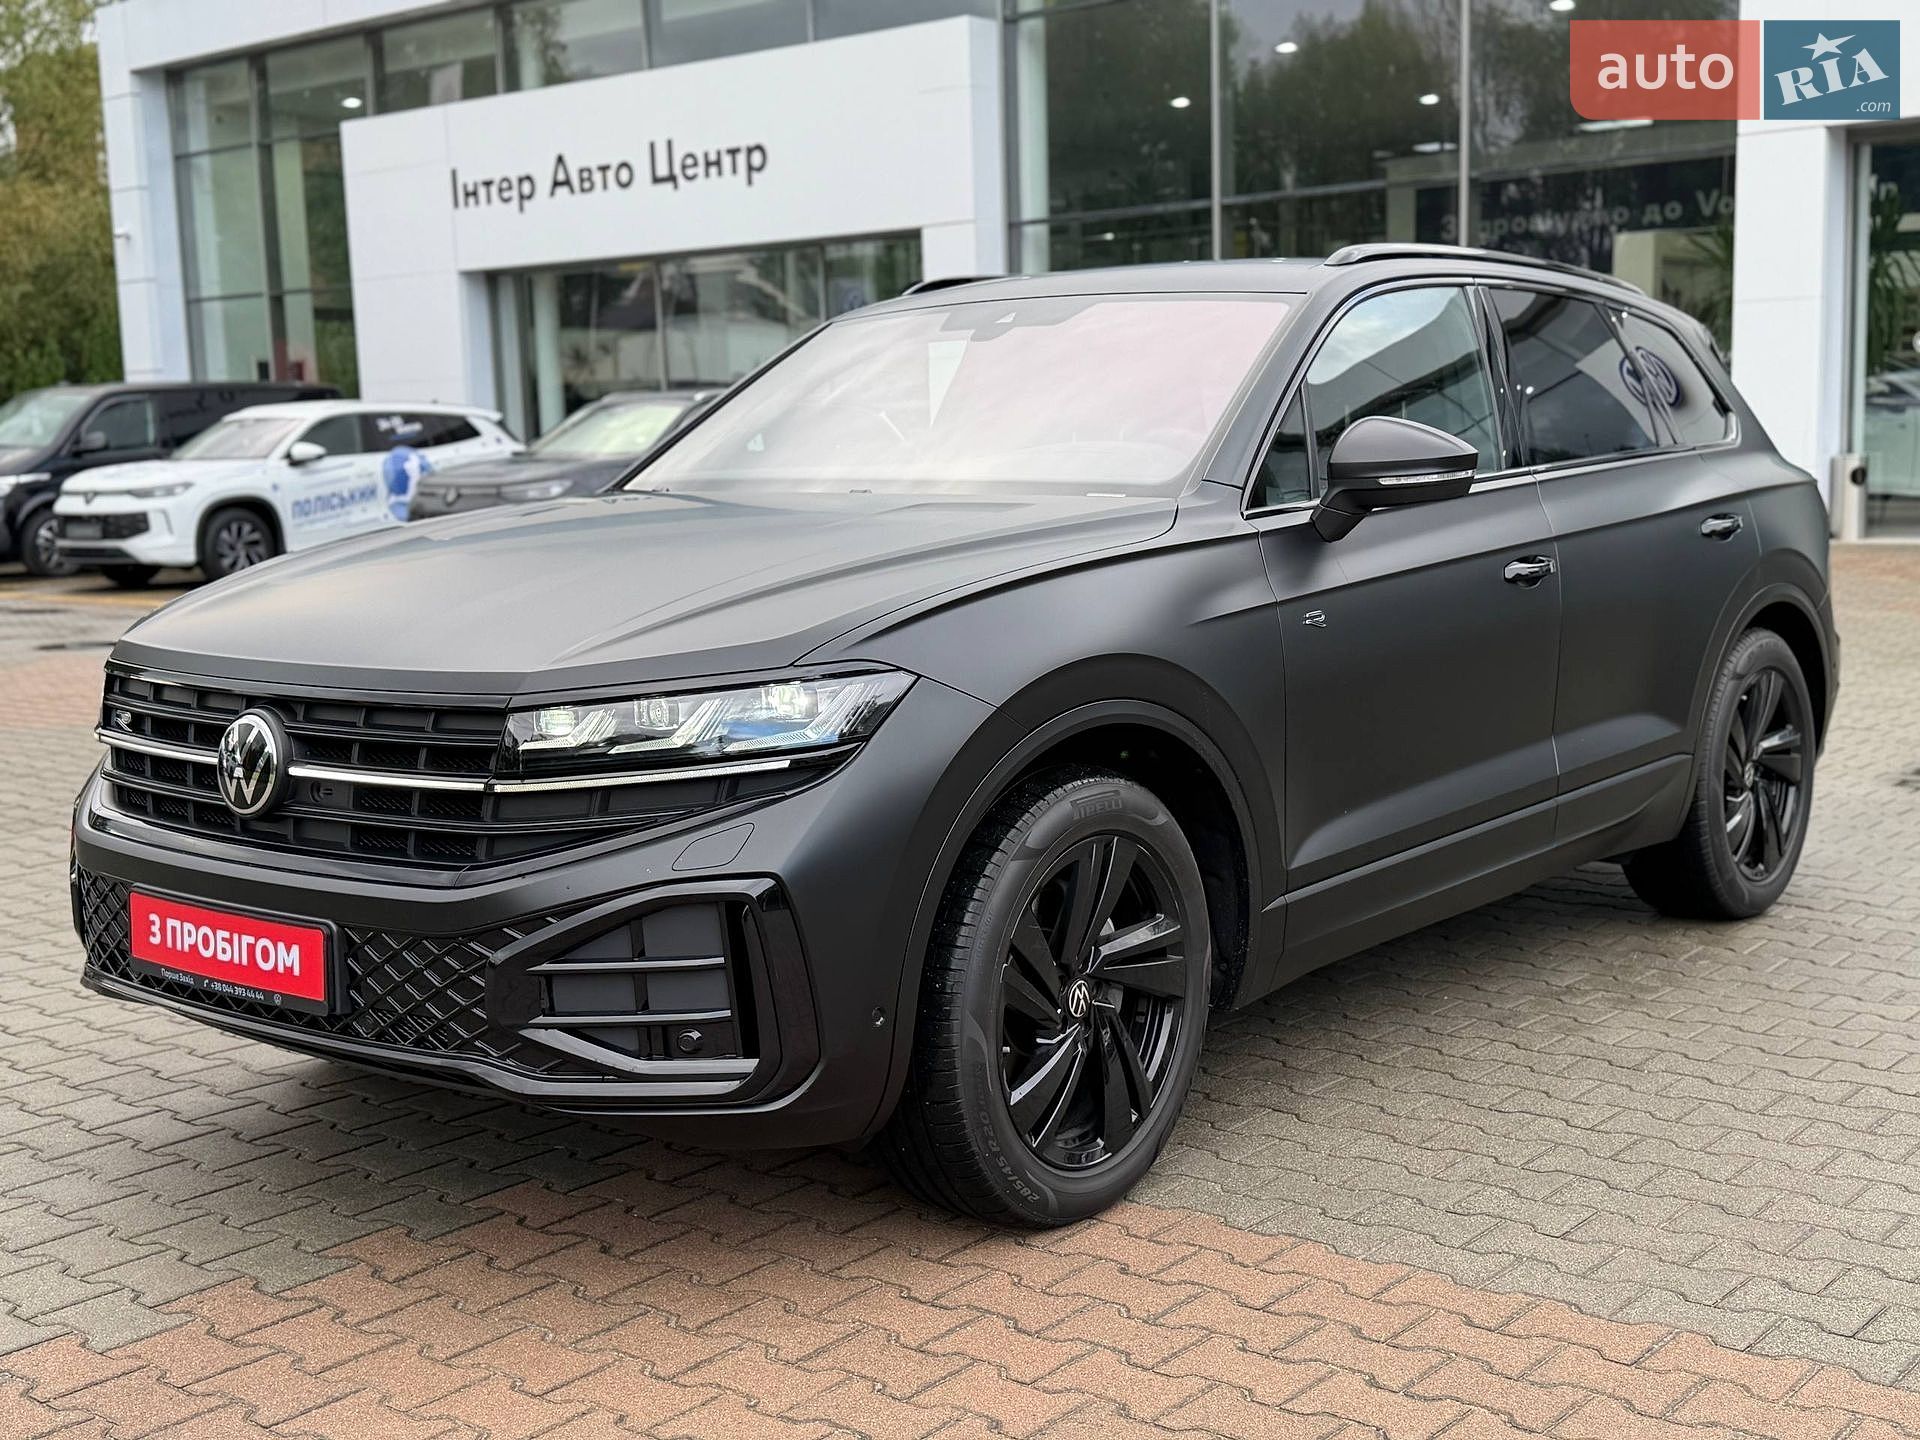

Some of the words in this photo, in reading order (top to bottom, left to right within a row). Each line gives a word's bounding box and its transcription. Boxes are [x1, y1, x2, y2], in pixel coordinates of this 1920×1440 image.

[451, 168, 536, 213] Інтер
[550, 153, 634, 197] Авто
[650, 138, 768, 187] Центр
[148, 913, 161, 945] З
[166, 918, 300, 977] ПРОБІГОМ
